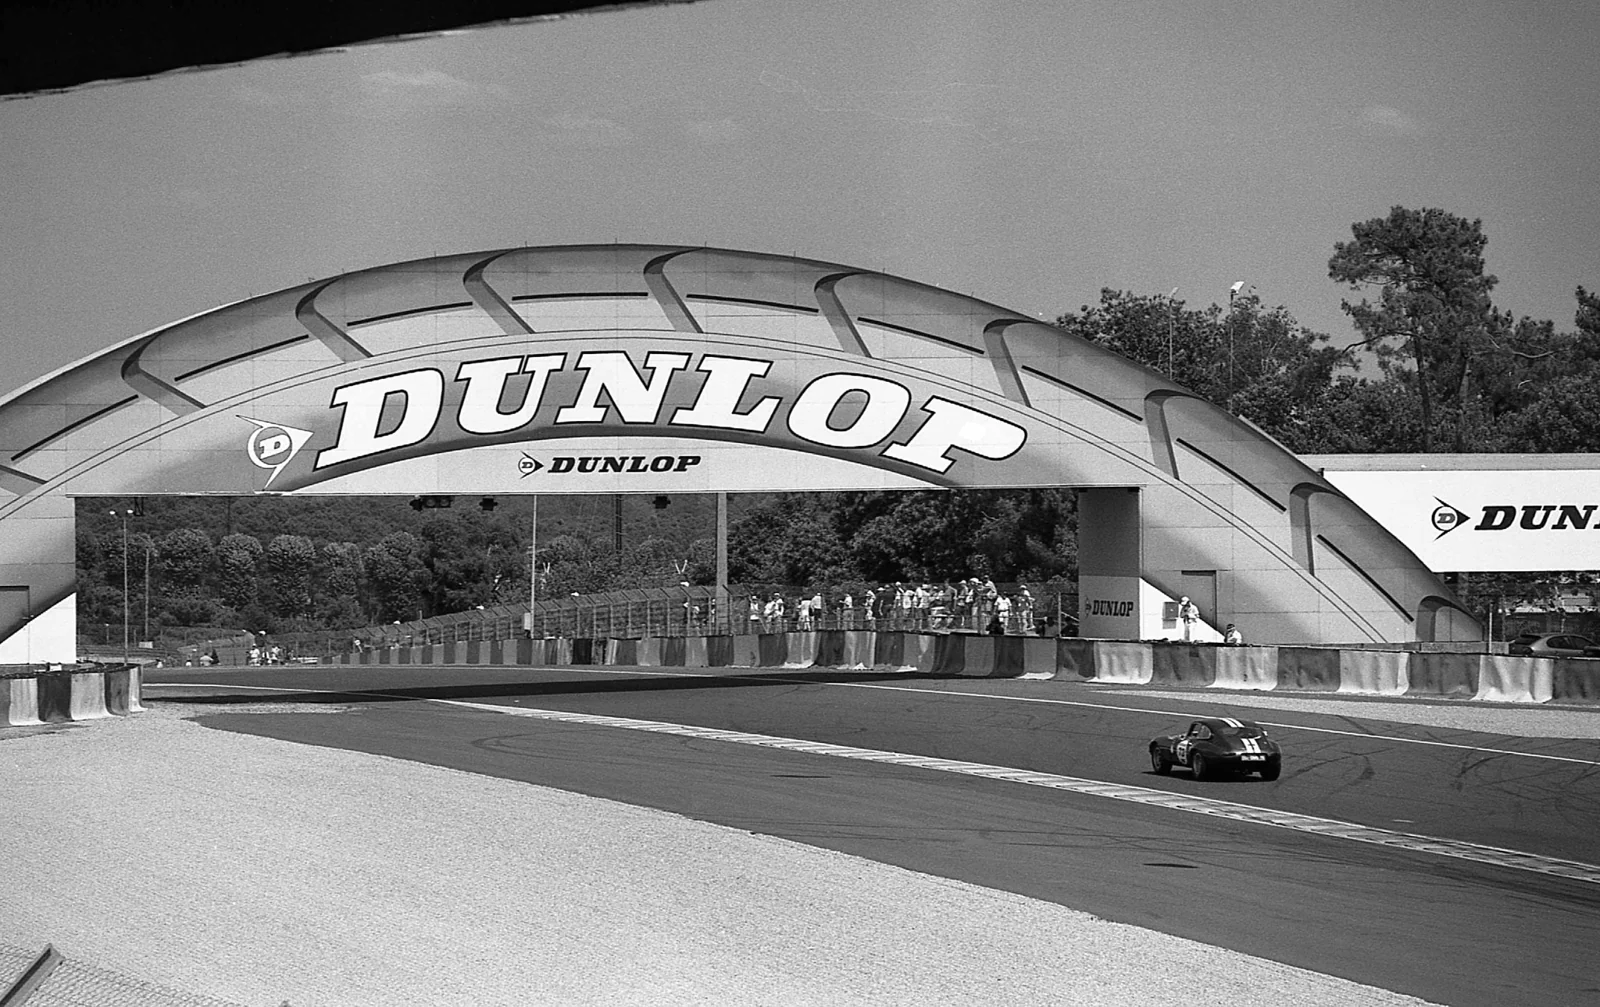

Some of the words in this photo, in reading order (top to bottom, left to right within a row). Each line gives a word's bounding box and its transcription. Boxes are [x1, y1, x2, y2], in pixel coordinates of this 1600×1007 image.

[313, 351, 1027, 475] DUNLOP
[547, 455, 701, 473] DUNLOP
[1474, 505, 1600, 531] DUN
[1092, 600, 1134, 617] DUNLOP
